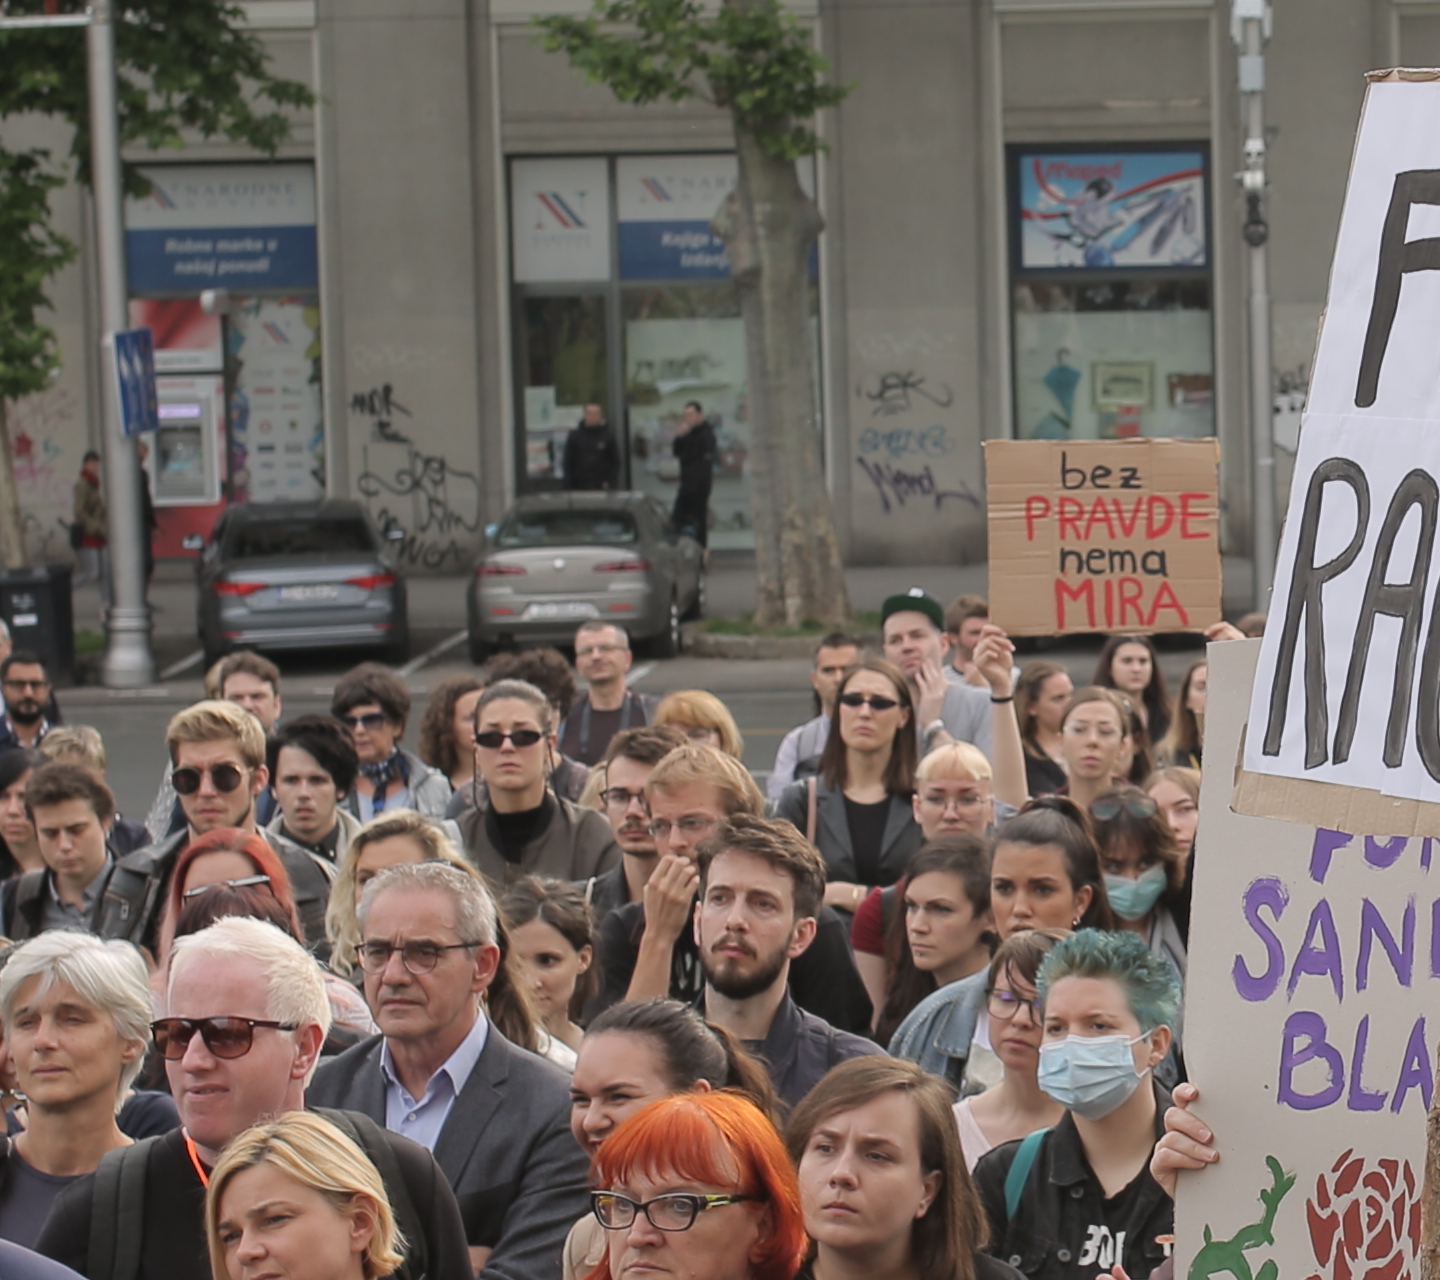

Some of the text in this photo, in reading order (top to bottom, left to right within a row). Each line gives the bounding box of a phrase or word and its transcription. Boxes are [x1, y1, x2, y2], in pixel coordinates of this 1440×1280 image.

[1061, 451, 1143, 489] bez
[1025, 493, 1211, 542] PRAVDE
[1060, 547, 1169, 577] nema
[1055, 577, 1190, 630] MIRA
